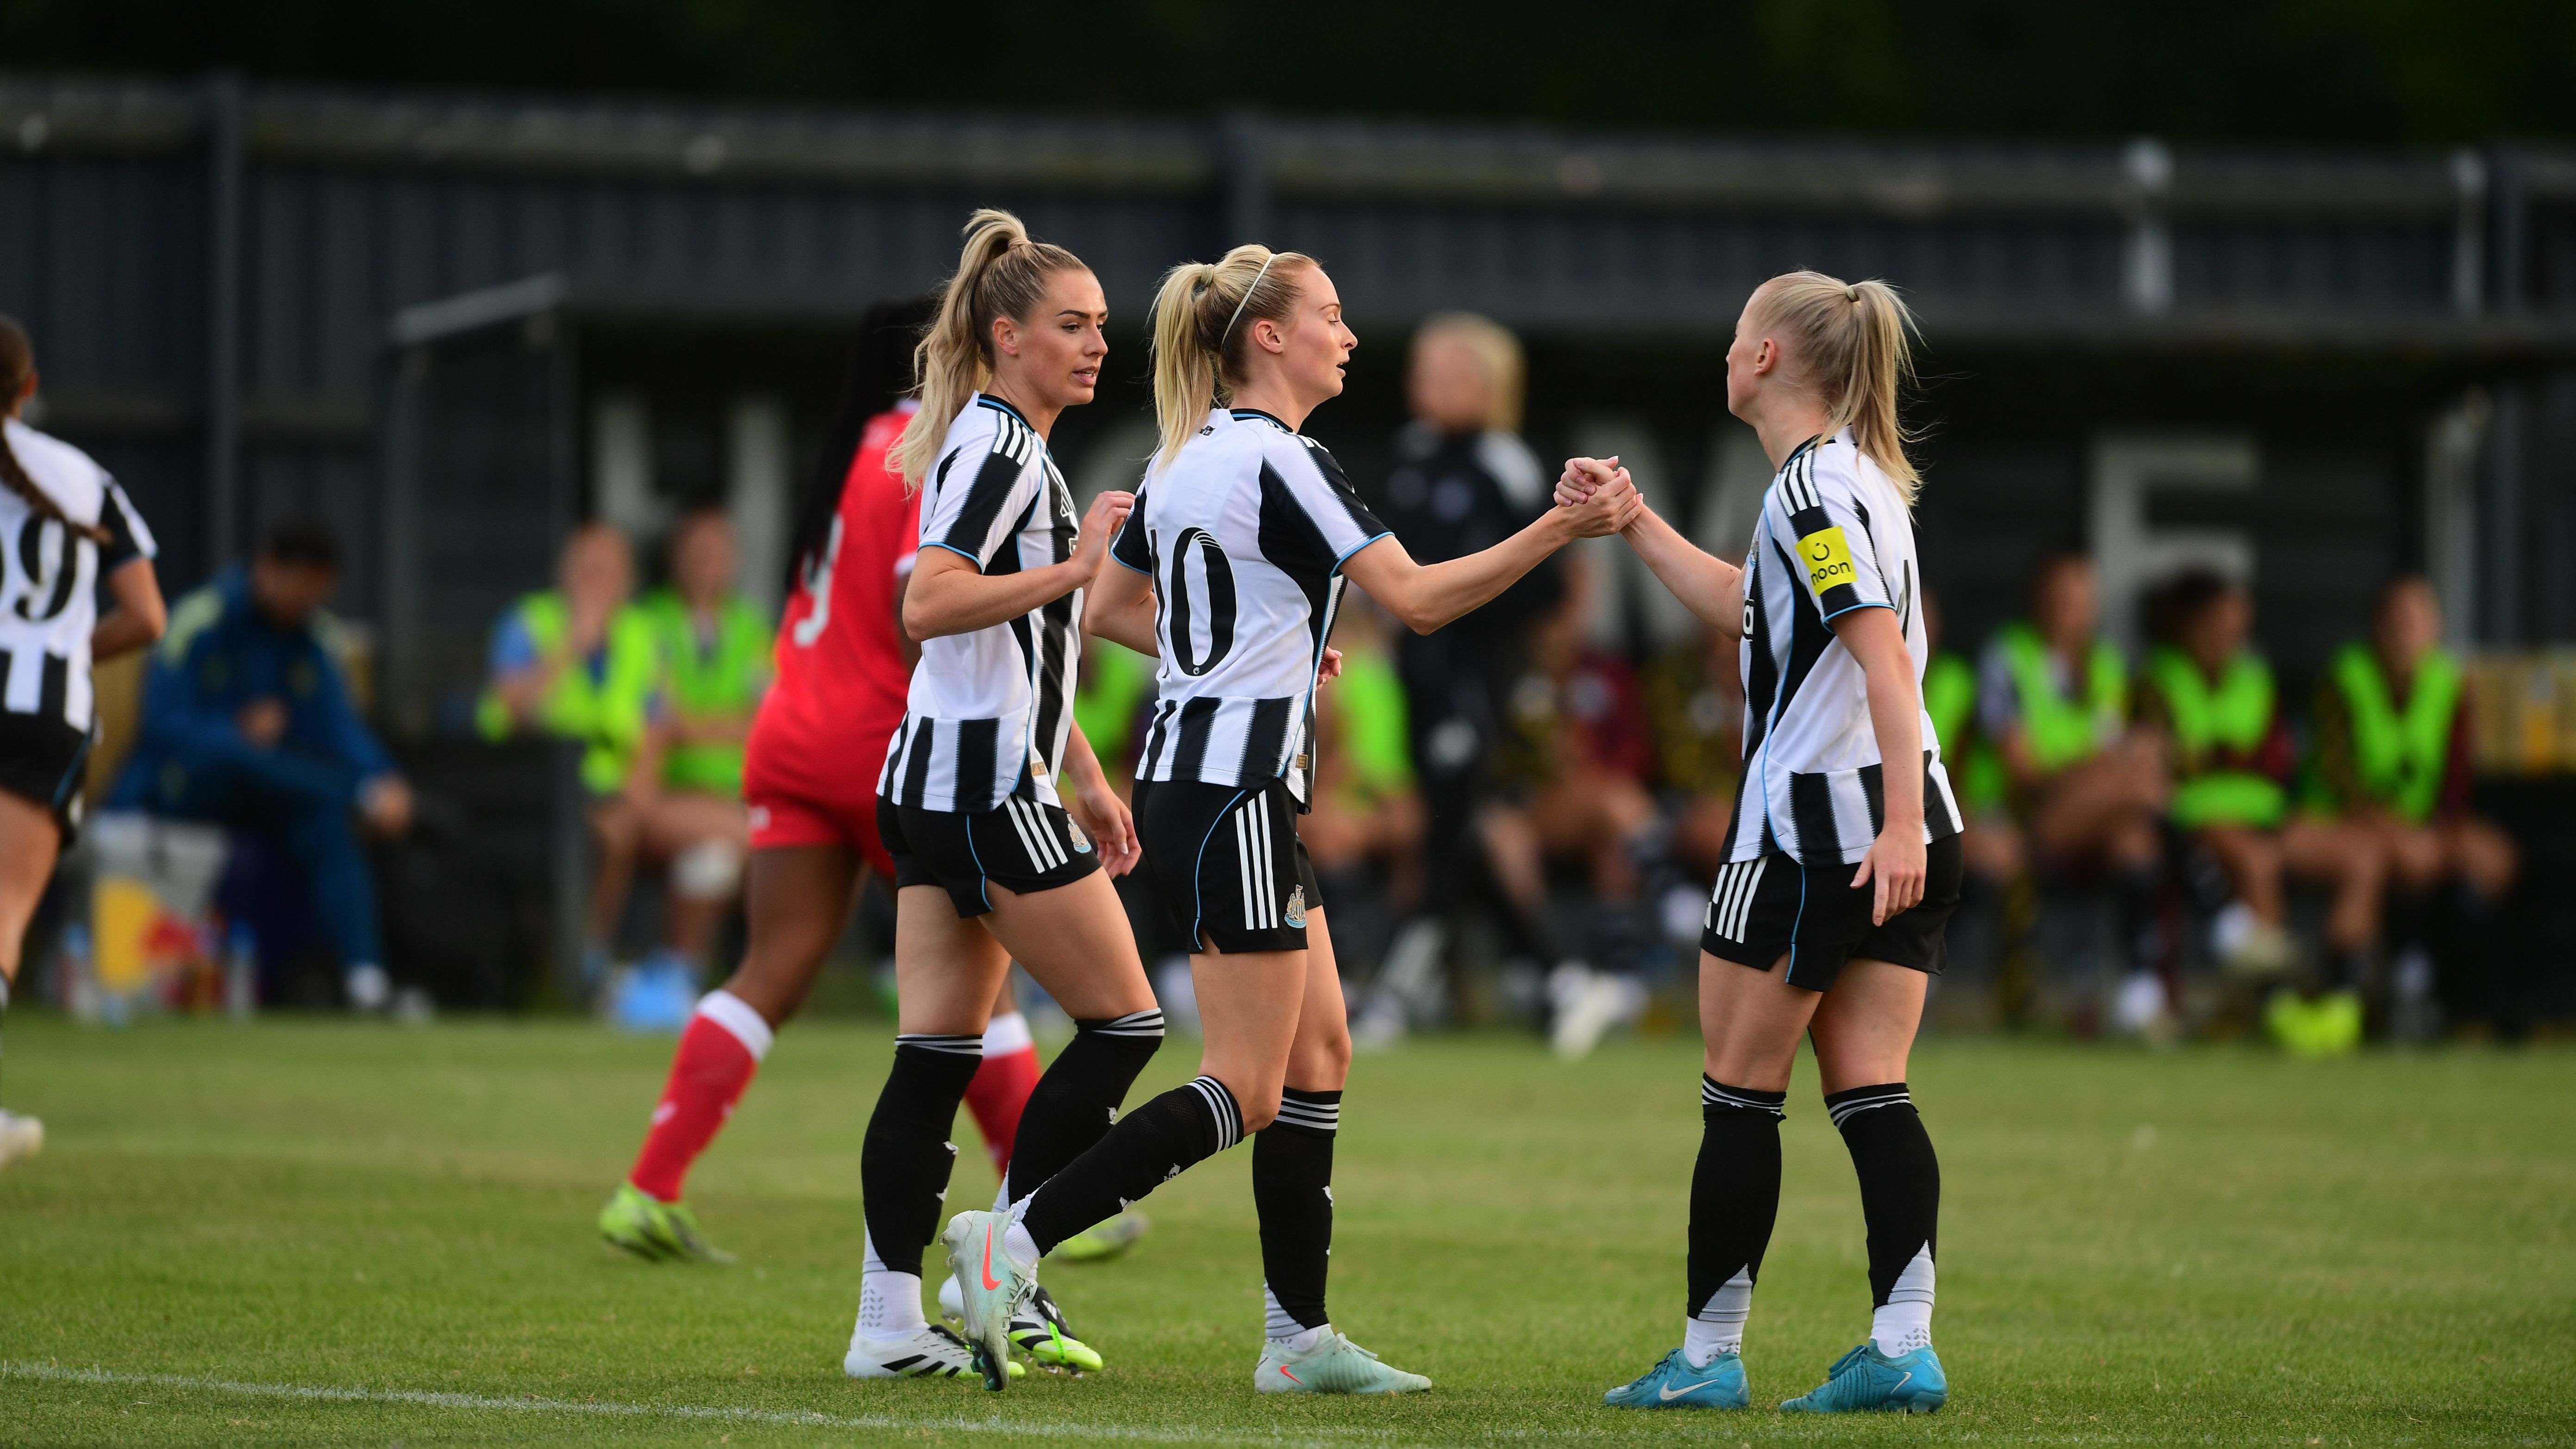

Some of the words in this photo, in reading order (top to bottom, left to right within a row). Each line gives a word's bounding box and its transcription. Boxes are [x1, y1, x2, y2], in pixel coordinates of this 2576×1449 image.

[0, 513, 77, 622] 9
[1149, 526, 1238, 678] 10
[1811, 562, 1851, 586] noon
